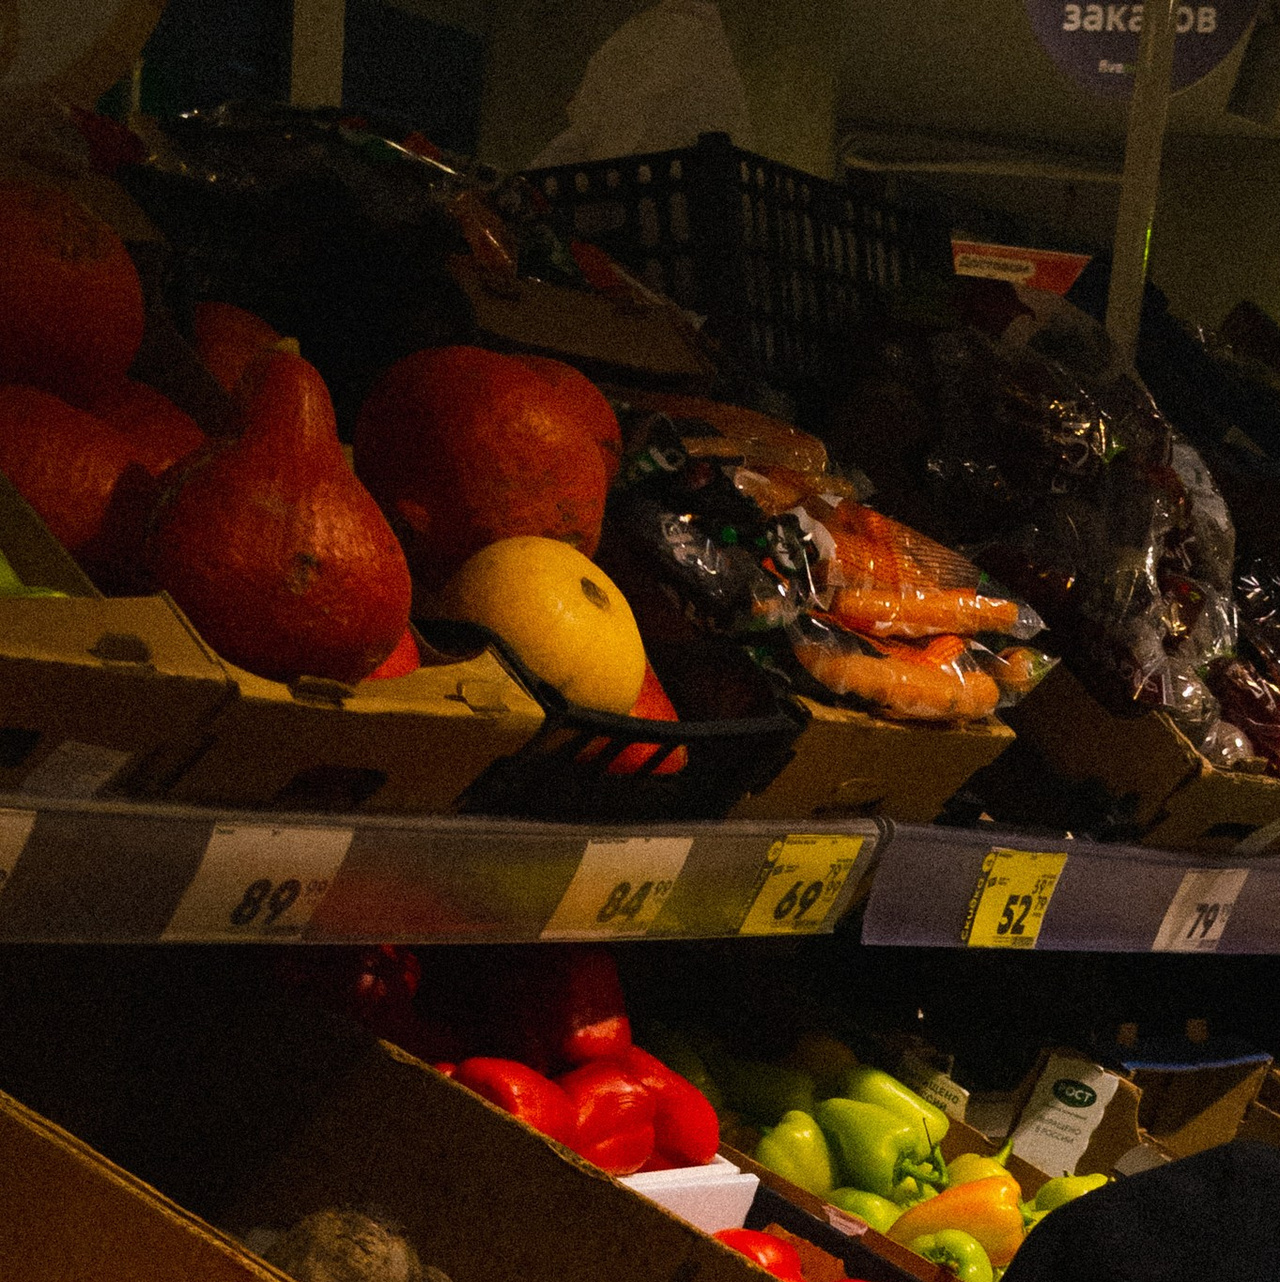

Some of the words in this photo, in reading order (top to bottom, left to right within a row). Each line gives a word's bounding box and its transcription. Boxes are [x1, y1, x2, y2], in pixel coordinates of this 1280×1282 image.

[1061, 3, 1218, 34] закаов
[229, 878, 301, 926] 89
[596, 881, 654, 923] 84
[773, 880, 825, 919] 69
[996, 894, 1033, 935] 52
[1186, 902, 1220, 939] 79
[1056, 1081, 1094, 1104] РОСТ
